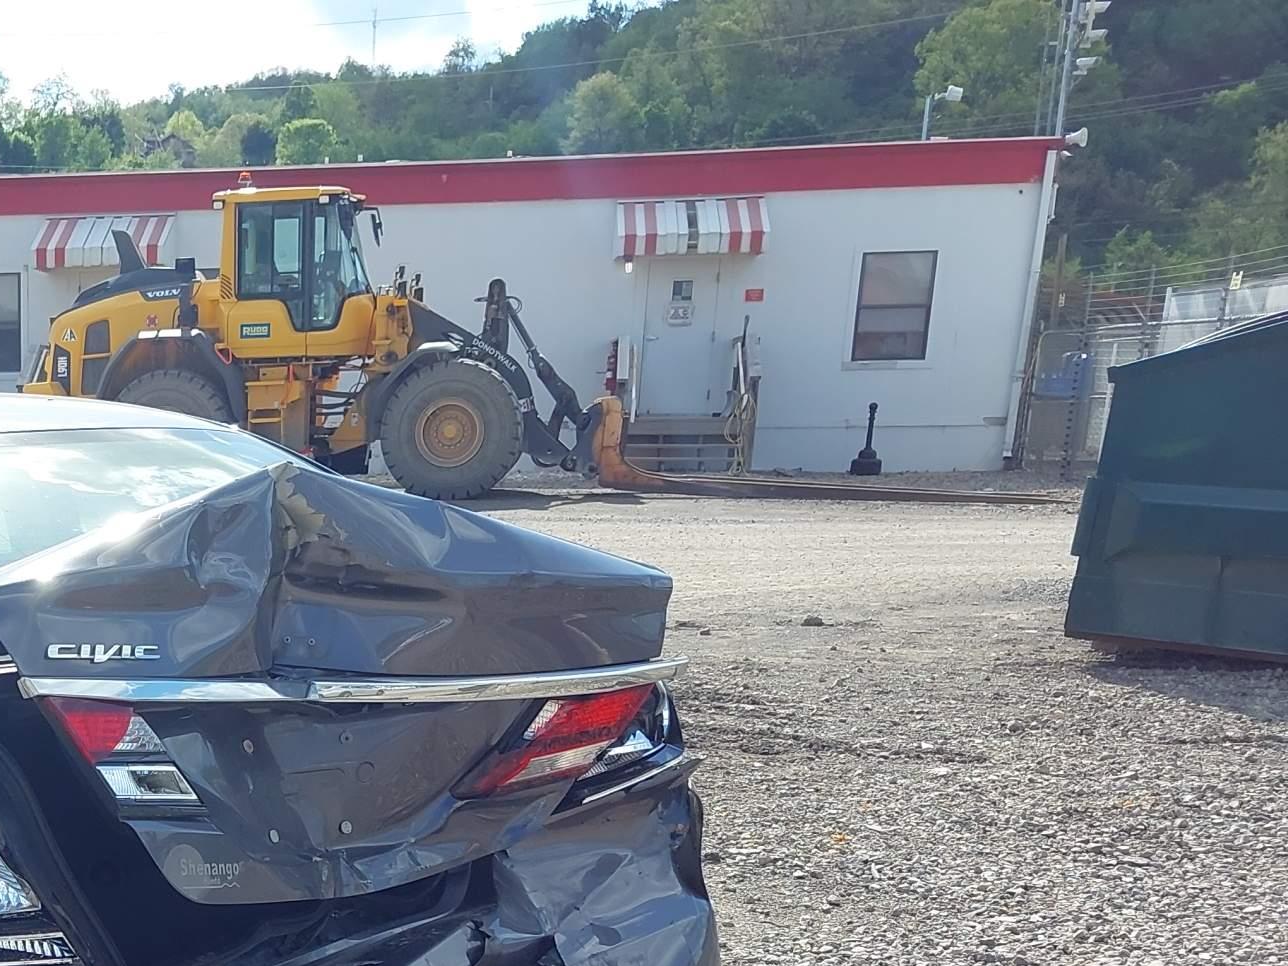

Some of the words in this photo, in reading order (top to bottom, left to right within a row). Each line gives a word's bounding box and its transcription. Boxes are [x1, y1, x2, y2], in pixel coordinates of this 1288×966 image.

[146, 288, 181, 298] VOLV
[46, 643, 161, 663] CIVIC
[180, 858, 239, 880] Shenango
